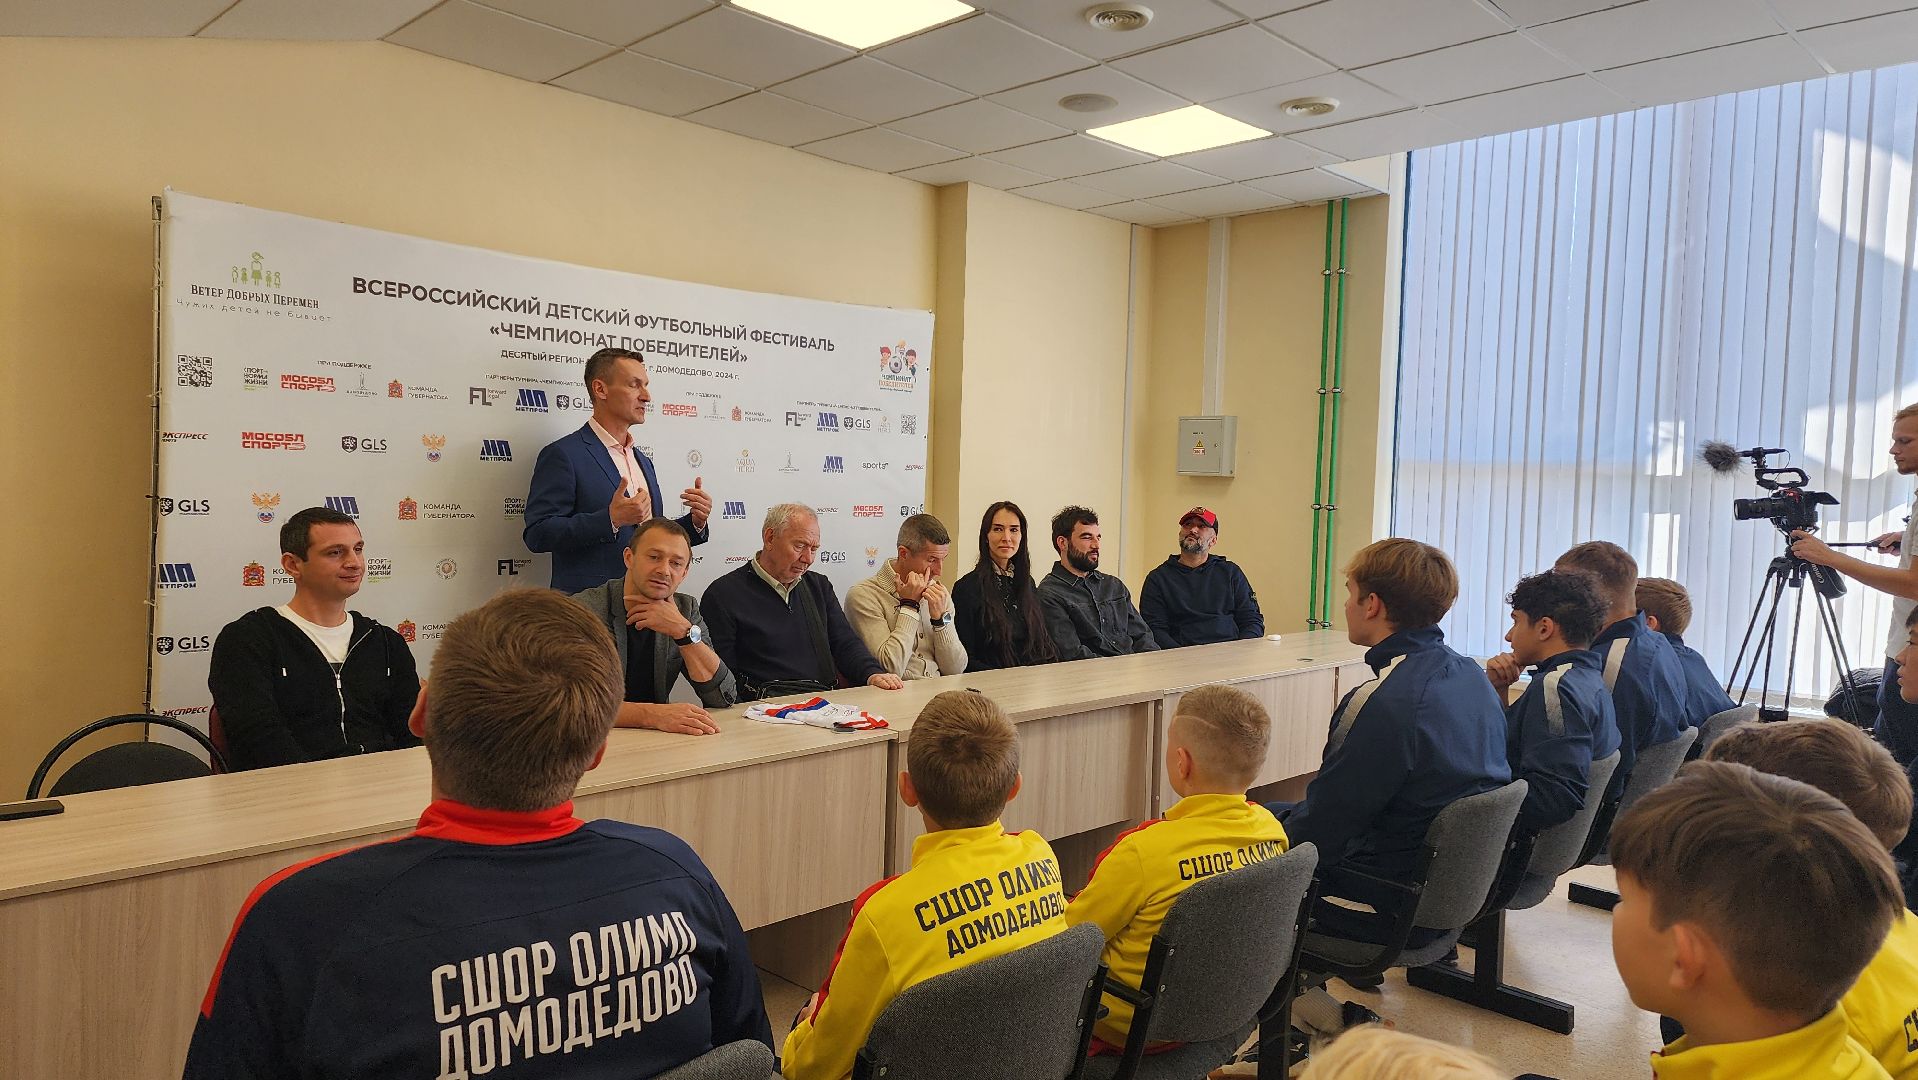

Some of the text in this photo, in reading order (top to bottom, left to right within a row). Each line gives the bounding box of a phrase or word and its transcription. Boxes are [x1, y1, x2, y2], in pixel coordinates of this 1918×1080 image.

[352, 276, 835, 352] ВСЕРОССИЙСКИЙ ДЕТСКИЙ ФУТБОЛЬНЫЙ ФЕСТИВАЛЬ
[500, 350, 547, 361] ДЕСЯТЫЙ
[621, 336, 748, 363] ПОБЕДИТЕЛЕЙ»
[715, 371, 733, 379] 2024
[855, 418, 871, 429] GLS
[241, 441, 290, 450] СПОРТ
[361, 438, 388, 451] GLS
[177, 499, 210, 513] GLS
[831, 552, 846, 561] GLS
[177, 635, 210, 650] GLS
[162, 706, 208, 717] ЭКСПРЕСС
[1179, 851, 1234, 881] СШОР
[914, 858, 1061, 932] СШОР ОЛИМП
[946, 891, 1065, 959] ДОМОДЕДОВО
[431, 911, 697, 1024] СШОР ОЛИМП
[435, 954, 697, 1080] ДОМОДЕДОВО
